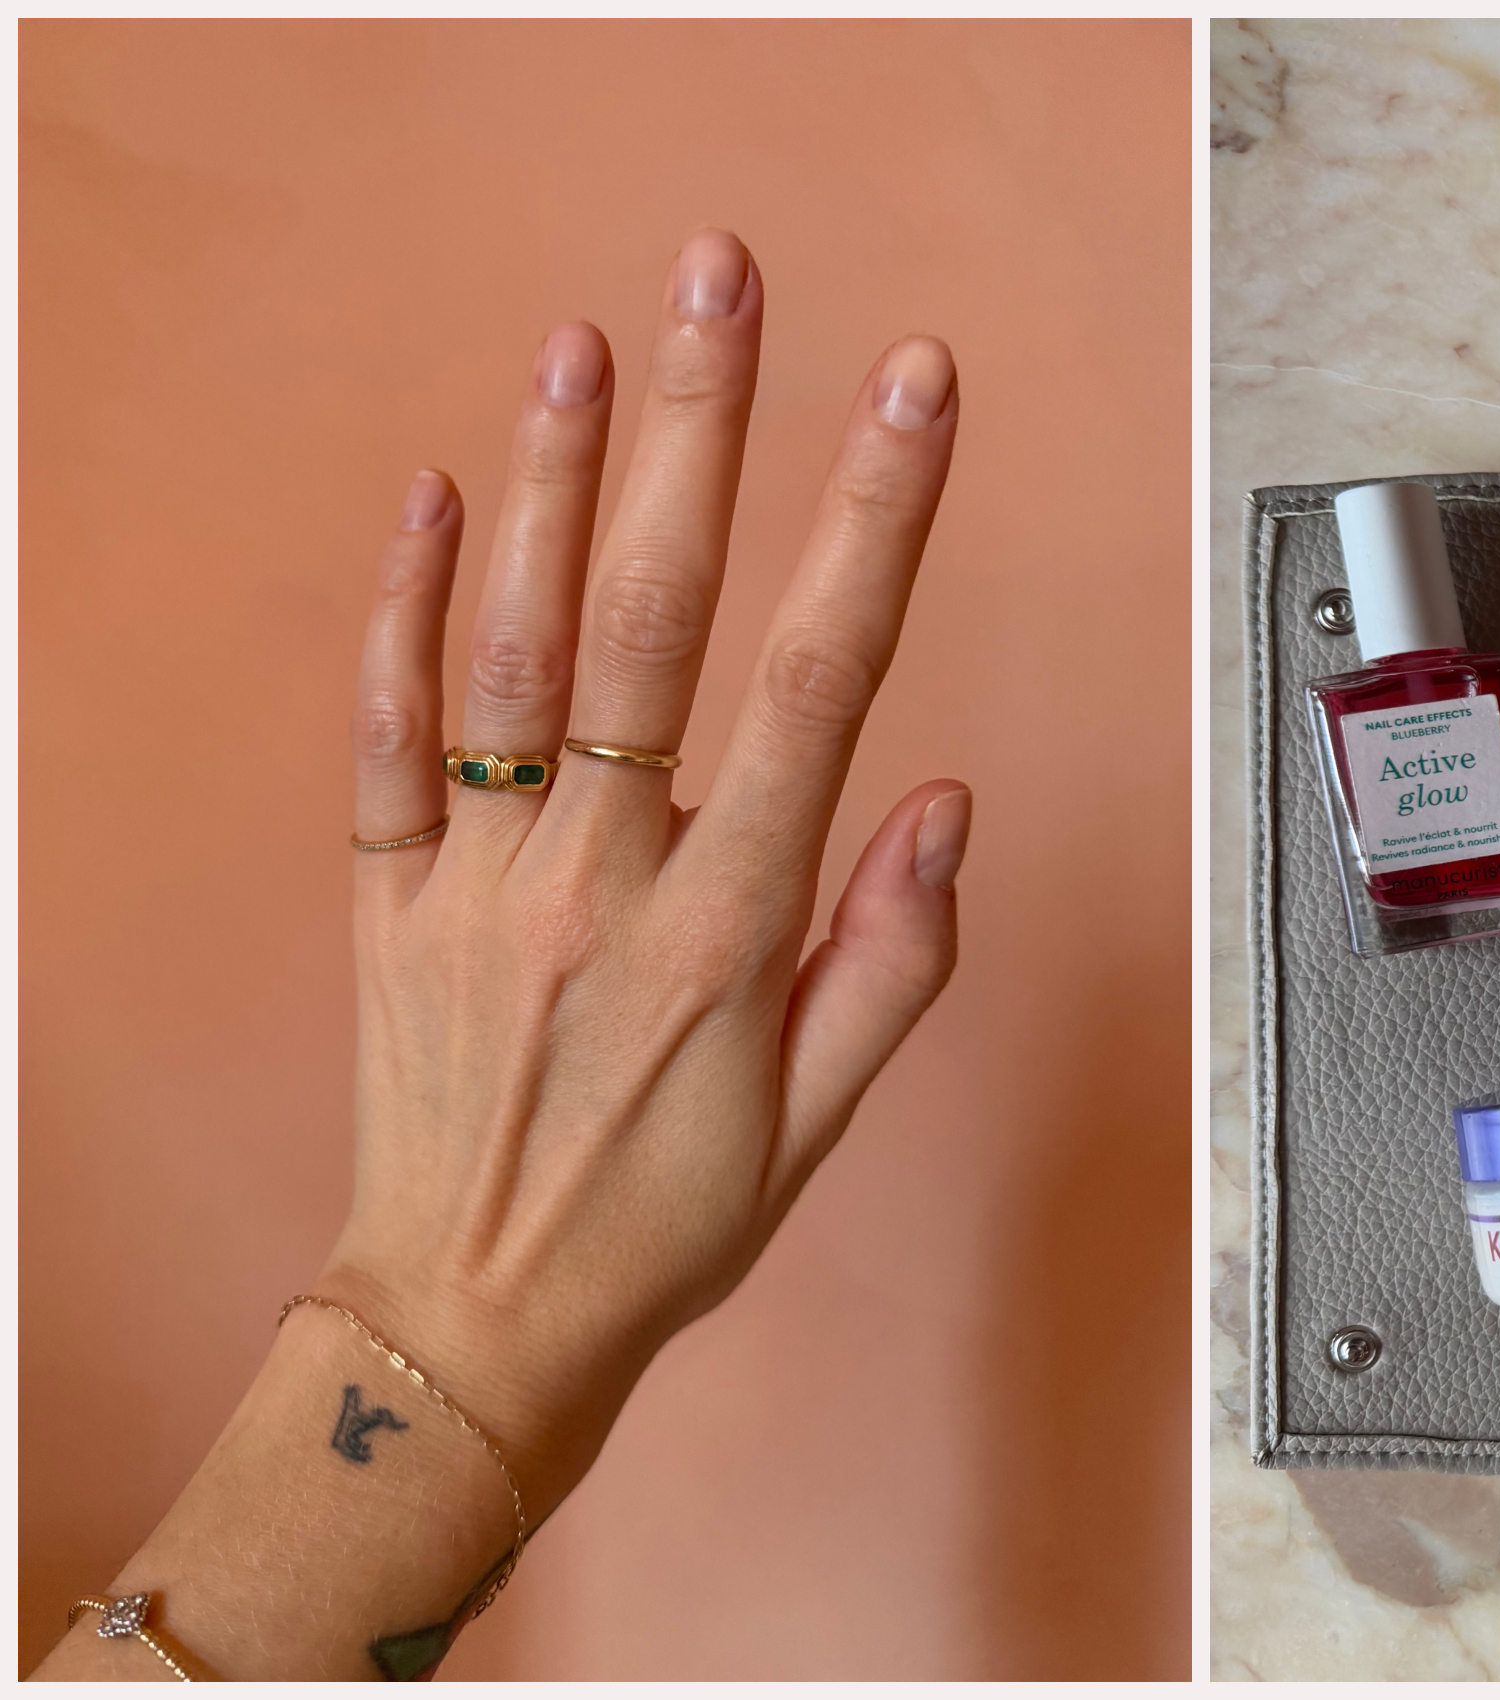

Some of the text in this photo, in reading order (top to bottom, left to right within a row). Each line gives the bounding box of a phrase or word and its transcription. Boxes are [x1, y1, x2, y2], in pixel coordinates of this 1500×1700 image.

[1366, 709, 1472, 731] NAIL CARE EFFECTS
[1391, 725, 1451, 741] BLUEBERRY
[1380, 750, 1476, 782] Active
[1398, 784, 1468, 816] glow
[1383, 835, 1417, 848] Ravive
[1454, 828, 1462, 836] &
[1464, 822, 1498, 834] nourrit
[1372, 851, 1409, 862] Revives
[1411, 844, 1455, 857] radiance
[1457, 840, 1466, 849] &
[1438, 889, 1468, 899] PARIS
